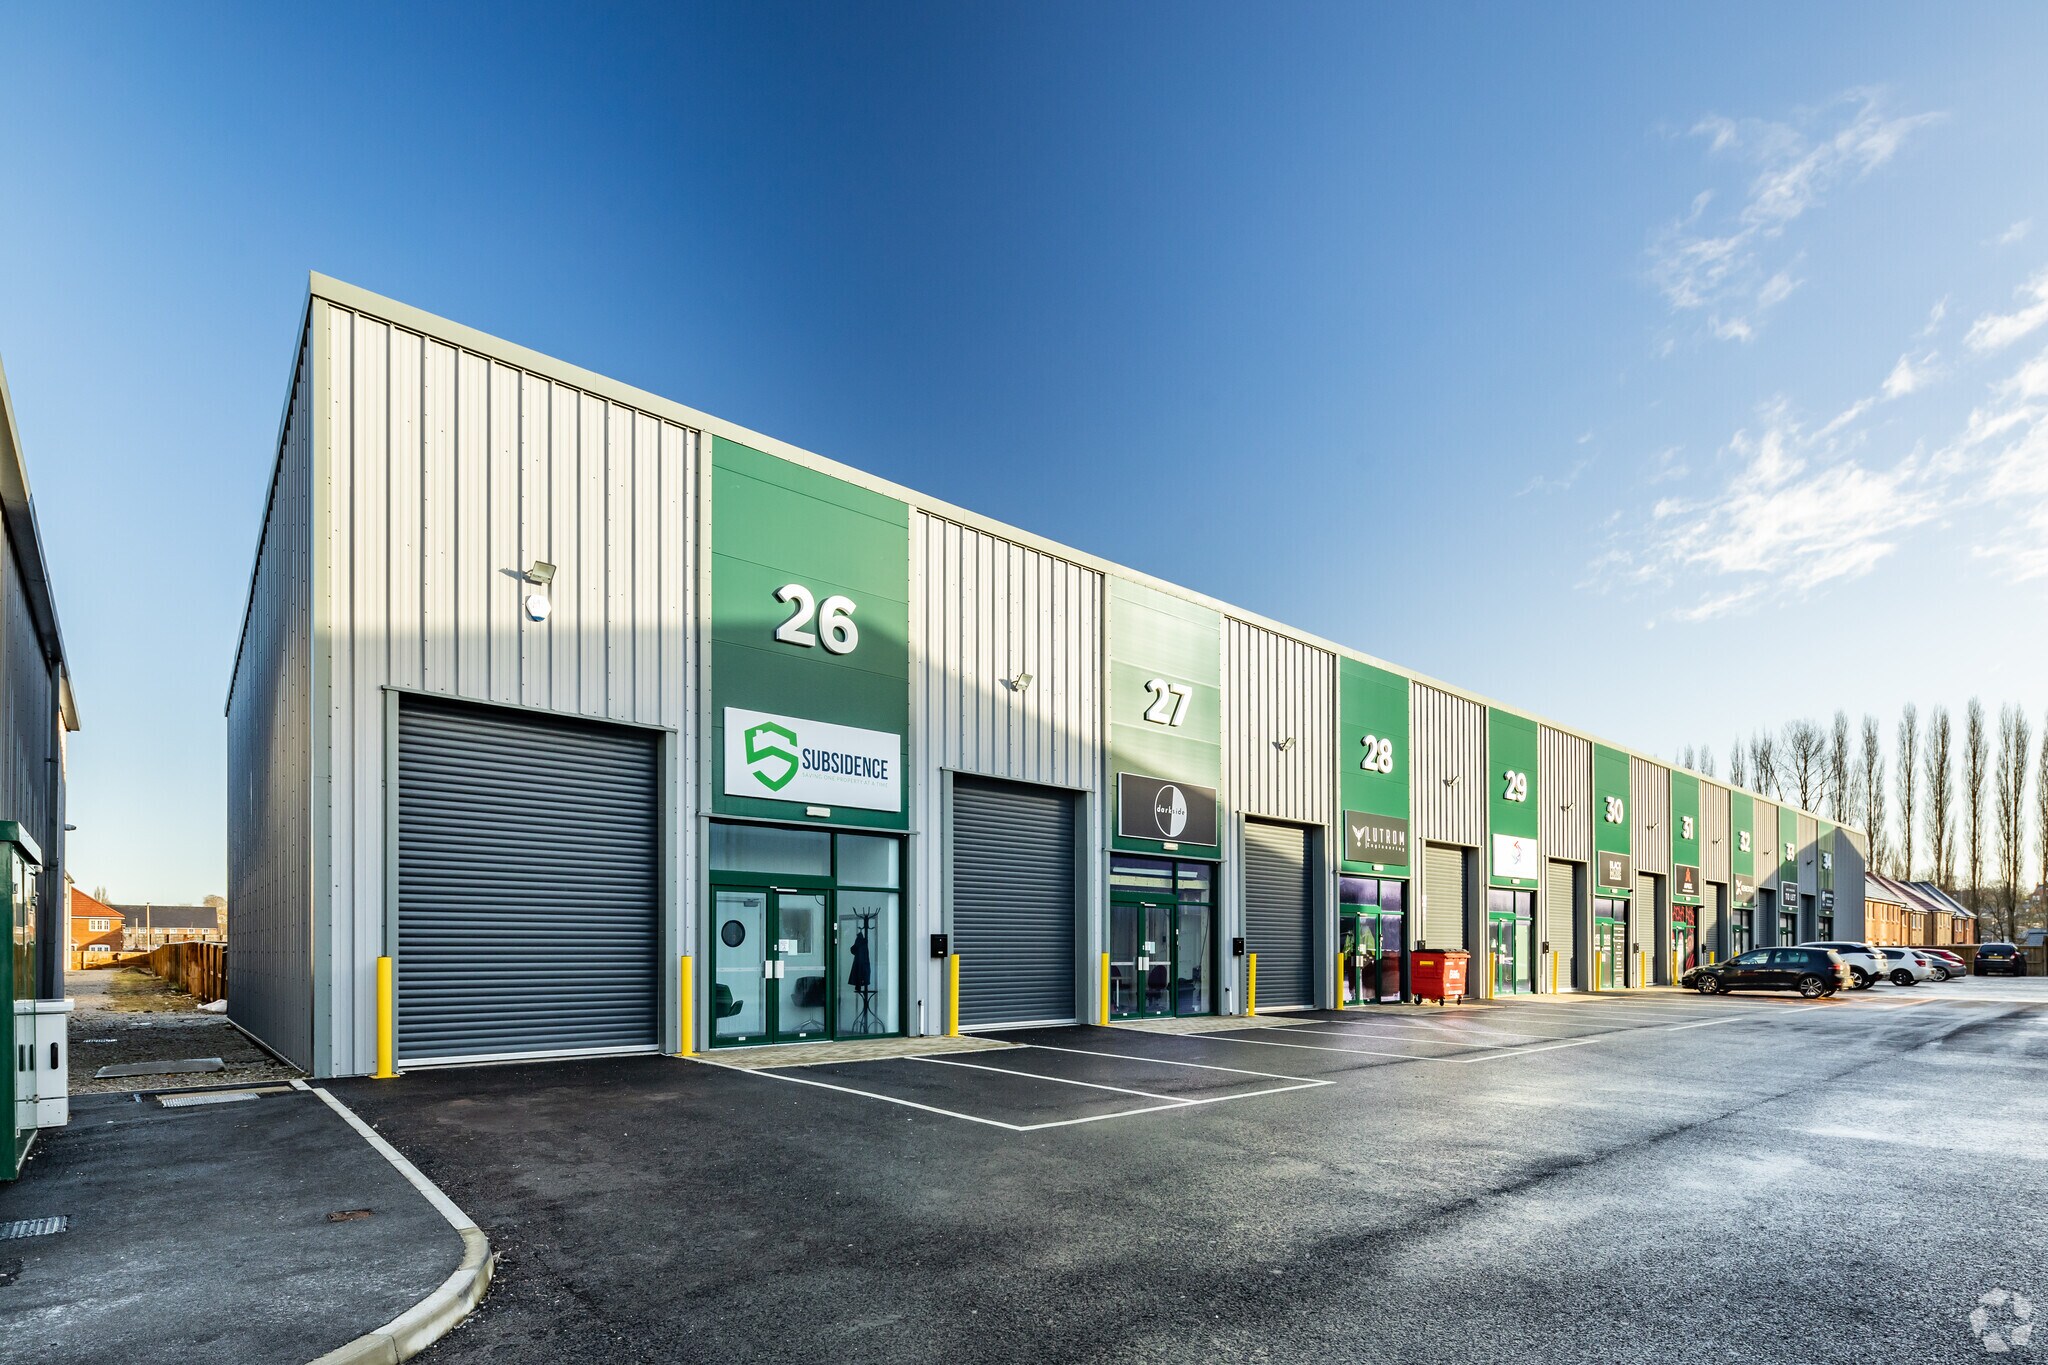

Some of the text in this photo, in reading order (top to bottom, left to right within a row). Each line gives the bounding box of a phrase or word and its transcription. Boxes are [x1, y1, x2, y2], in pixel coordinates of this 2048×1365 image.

[773, 584, 859, 654] 26
[1145, 678, 1193, 727] 27
[802, 748, 888, 780] SUBSIDENCE
[1361, 735, 1393, 773] 28
[837, 776, 863, 785] PROPERTY
[1503, 770, 1527, 802] 29
[1156, 804, 1185, 815] darkside
[1605, 796, 1624, 824] 30
[1681, 816, 1693, 839] 31
[1739, 831, 1751, 852] 32
